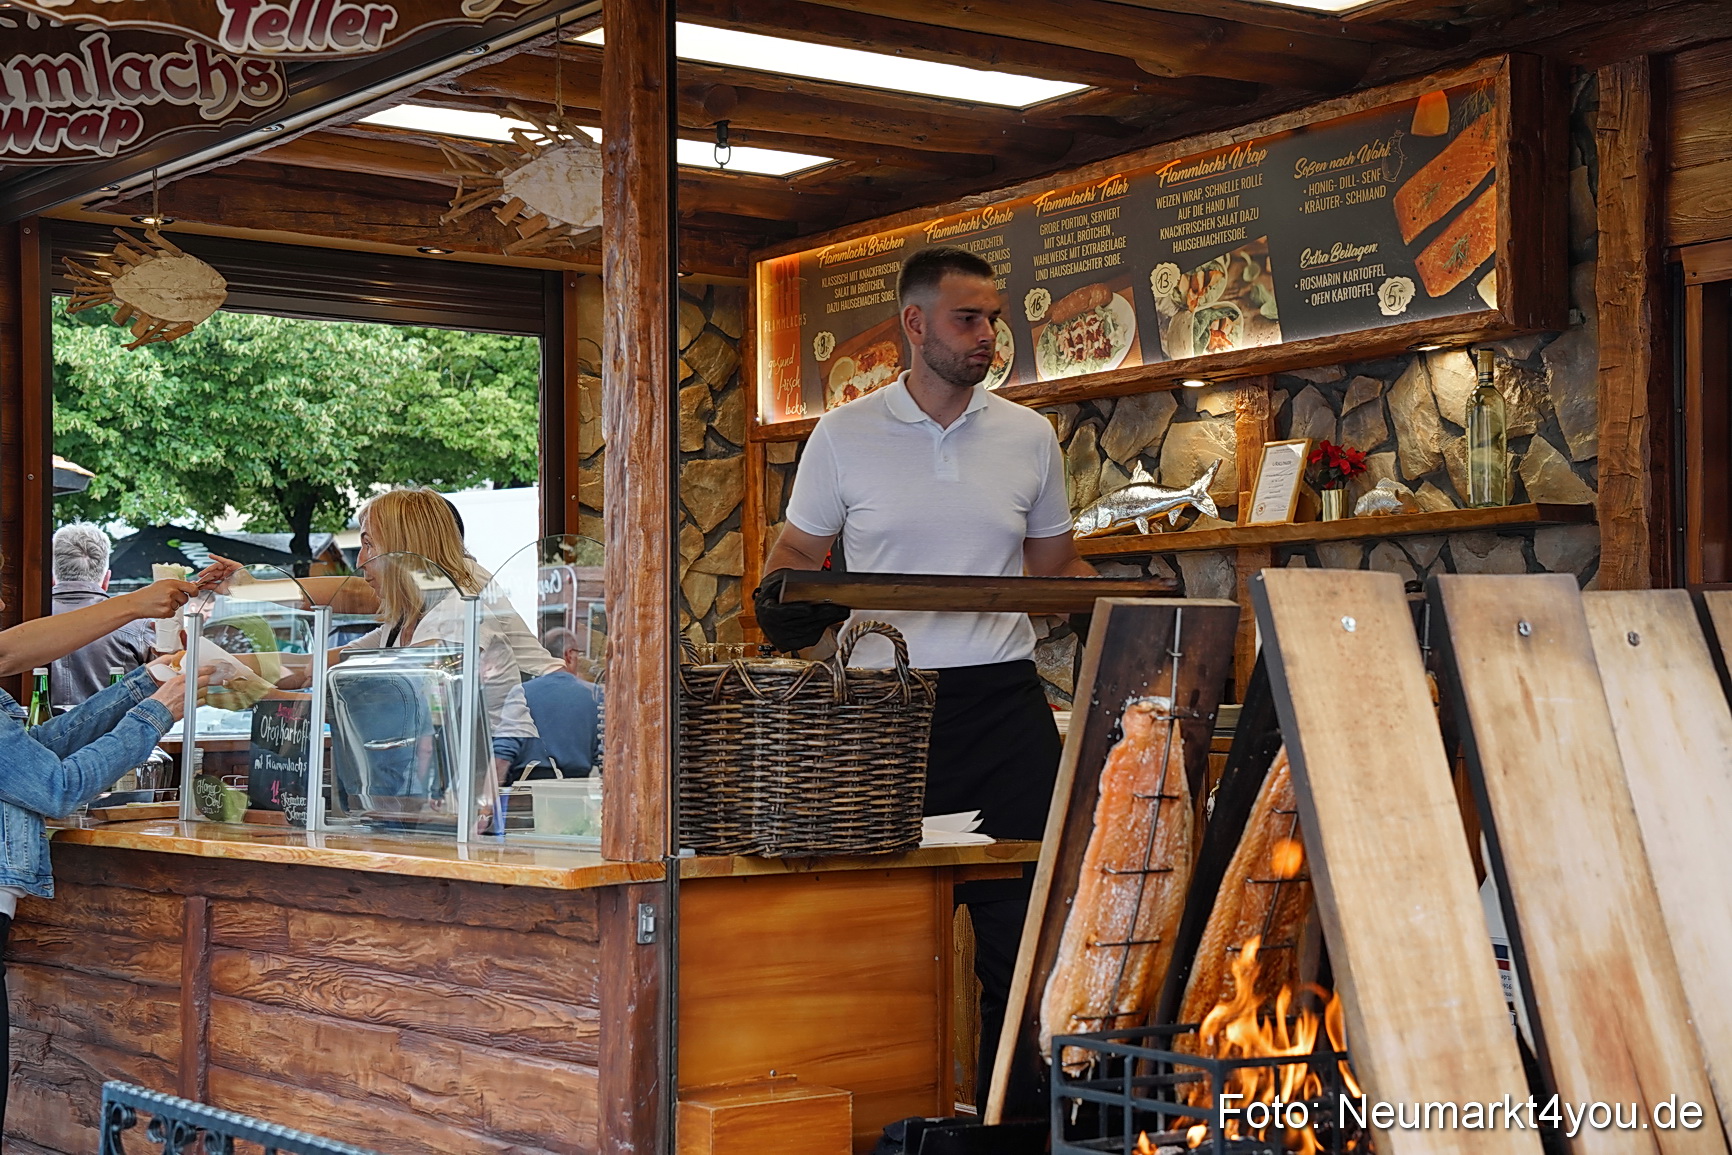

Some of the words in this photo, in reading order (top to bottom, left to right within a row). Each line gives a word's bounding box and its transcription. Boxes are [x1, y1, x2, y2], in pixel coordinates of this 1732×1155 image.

[220, 0, 397, 53] Teller
[0, 104, 143, 157] Wrap
[1154, 153, 1228, 189] Flammlachs
[1229, 140, 1268, 169] Wrap
[1294, 157, 1328, 179] Soßen
[1329, 151, 1355, 169] nach
[1032, 186, 1096, 217] Flammlachs
[1096, 174, 1130, 201] Teller
[1155, 192, 1181, 210] WEIZEN
[1181, 187, 1204, 204] WRAP,
[1205, 179, 1240, 199] SCHNELLE
[1241, 173, 1263, 190] ROLLE
[1308, 179, 1337, 197] HONIG-
[1339, 174, 1360, 190] DILL-
[1361, 168, 1381, 185] SENF
[1178, 206, 1192, 221] AUF
[1193, 204, 1204, 218] DIE
[1205, 199, 1225, 214] HAND
[1226, 195, 1240, 210] MIT
[1304, 194, 1344, 214] KRÄUTER-
[1345, 185, 1387, 205] SCHMAND
[923, 214, 980, 243] Flammlachs
[981, 206, 1014, 229] Schale
[1090, 206, 1121, 223] SERVIERT
[1160, 217, 1216, 241] KNACKFRISCHEN
[1216, 211, 1239, 228] SALAT
[1240, 207, 1259, 223] DAZU
[816, 243, 867, 268] Flammlachs
[867, 236, 905, 256] Brötchen
[970, 234, 1004, 252] VERZICHTEN
[987, 247, 1011, 262] GENUSS
[1033, 249, 1068, 267] WAHLWEISE
[1069, 246, 1080, 259] MIT
[1081, 236, 1127, 257] EXTRABEILAGE
[1044, 236, 1055, 249] MIT
[998, 262, 1011, 275] UND
[1035, 268, 1049, 281] UND
[1049, 257, 1103, 278] HAUSGEMACHTER
[1300, 248, 1330, 269] Extra
[821, 273, 849, 288] KLASSISCH
[849, 270, 859, 281] MIT
[859, 261, 901, 280] KNACKFRISCHEN
[1300, 273, 1341, 291] ROSMARIN
[1342, 264, 1386, 283] KARTOFFEL
[826, 302, 840, 314] DAZU
[840, 293, 880, 311] HAUSGEMACHTE
[834, 286, 850, 299] SALAT
[850, 284, 857, 295] IM
[1311, 291, 1331, 306] OFEN
[1331, 283, 1375, 303] KARTOFFEL
[764, 313, 807, 333] FLAMMLACHS
[776, 366, 801, 400] frisch
